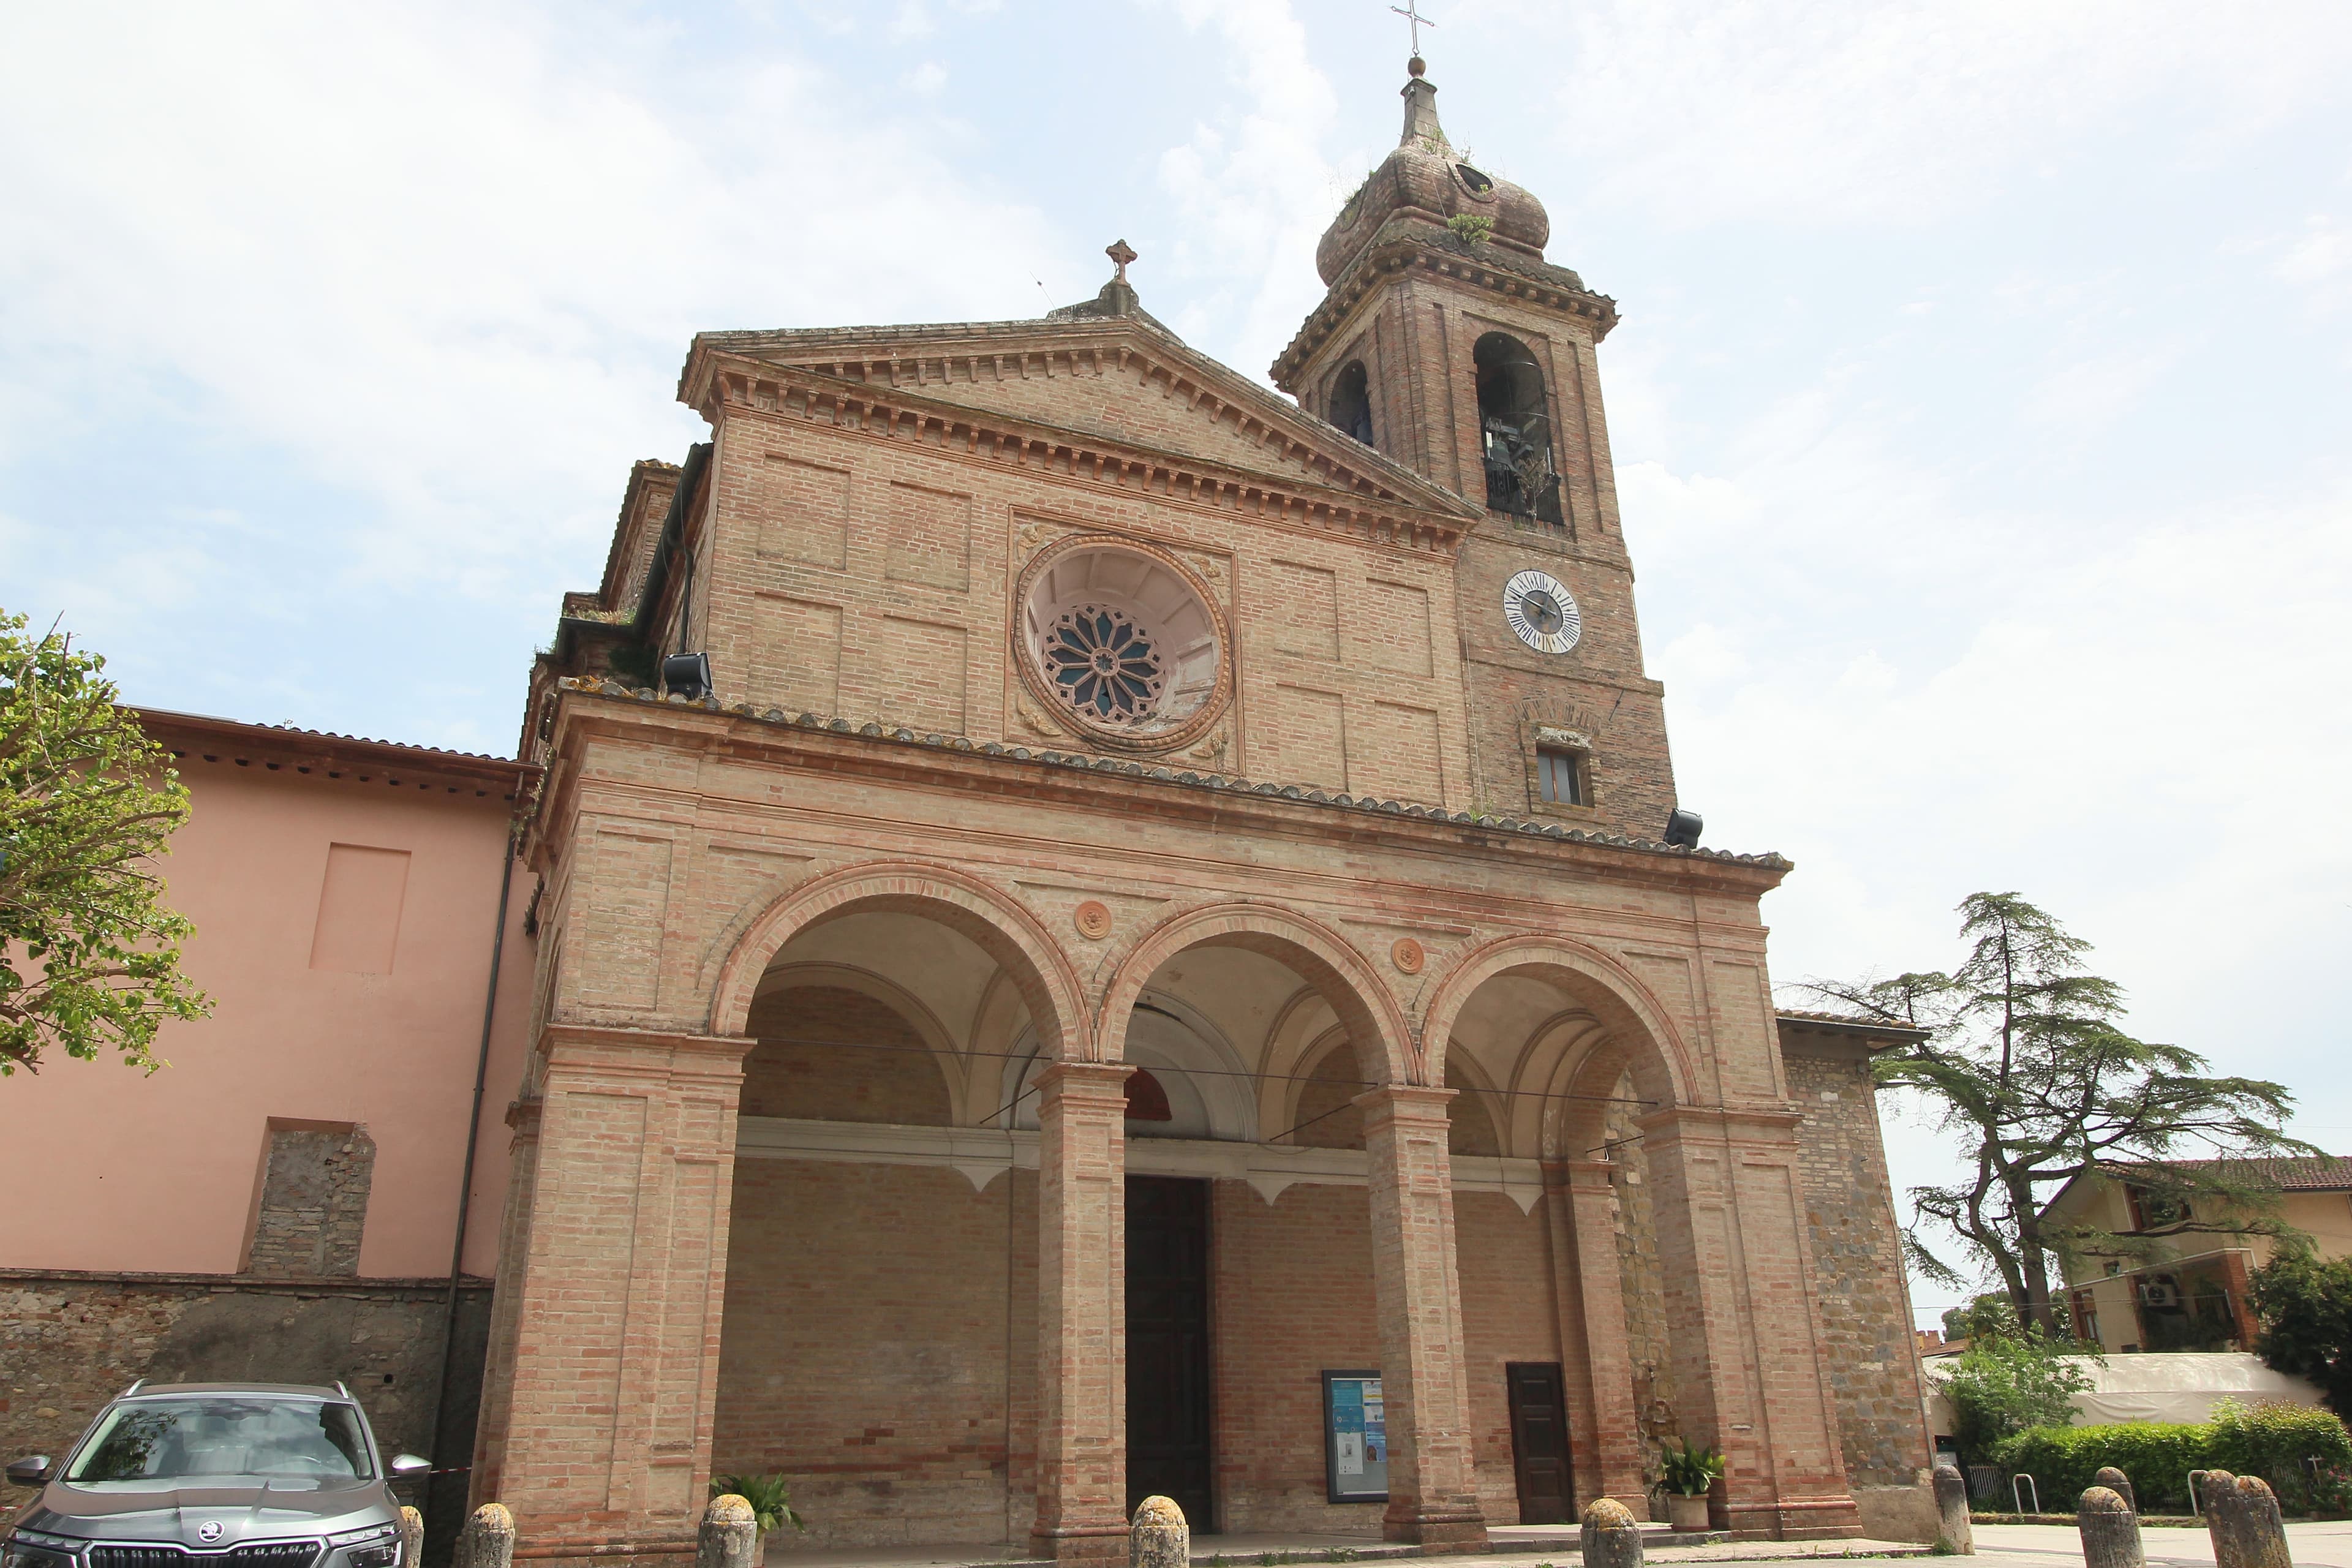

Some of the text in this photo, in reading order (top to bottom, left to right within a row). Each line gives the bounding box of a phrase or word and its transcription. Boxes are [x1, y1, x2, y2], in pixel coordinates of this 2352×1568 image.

[1533, 573, 1545, 589] XII
[1559, 596, 1574, 608] II
[1564, 613, 1580, 625] III
